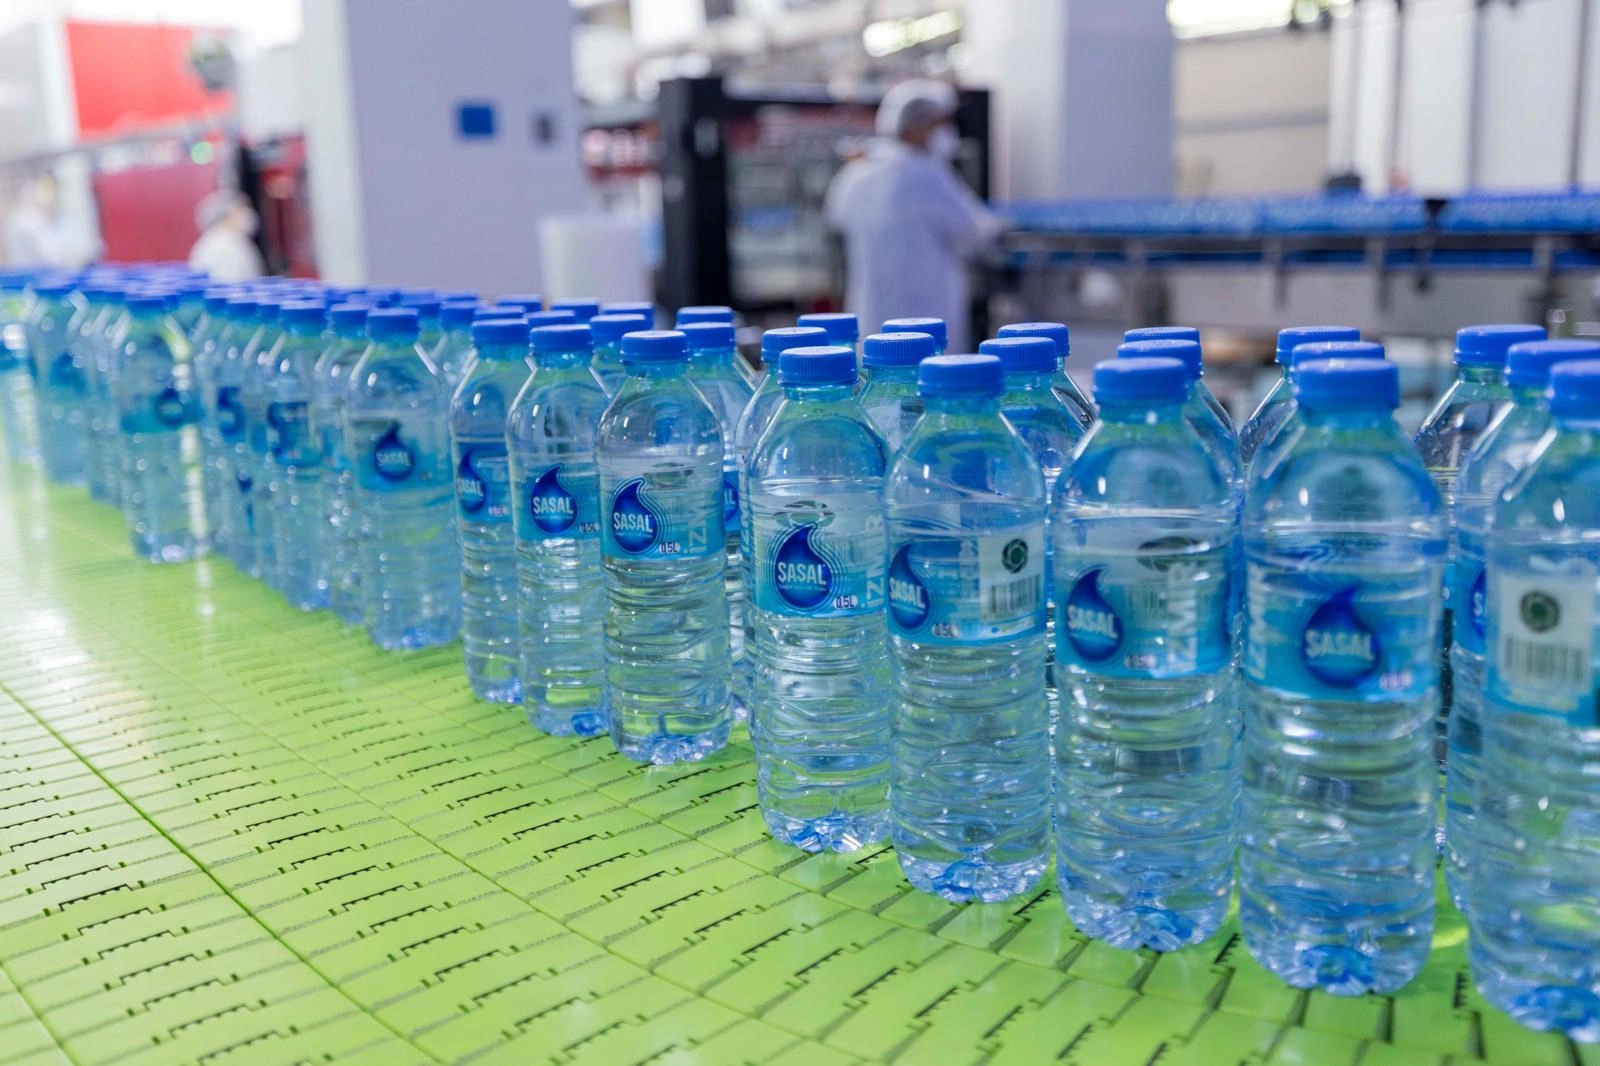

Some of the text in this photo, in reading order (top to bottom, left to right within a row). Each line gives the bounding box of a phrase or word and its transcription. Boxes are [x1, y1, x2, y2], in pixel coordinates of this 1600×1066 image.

[532, 496, 574, 514] SASAL
[613, 511, 653, 533] SASAL
[778, 561, 827, 586] SASAL
[889, 576, 926, 609] SASAL
[1066, 604, 1119, 640] SASAL
[1304, 627, 1374, 662] SASAL
